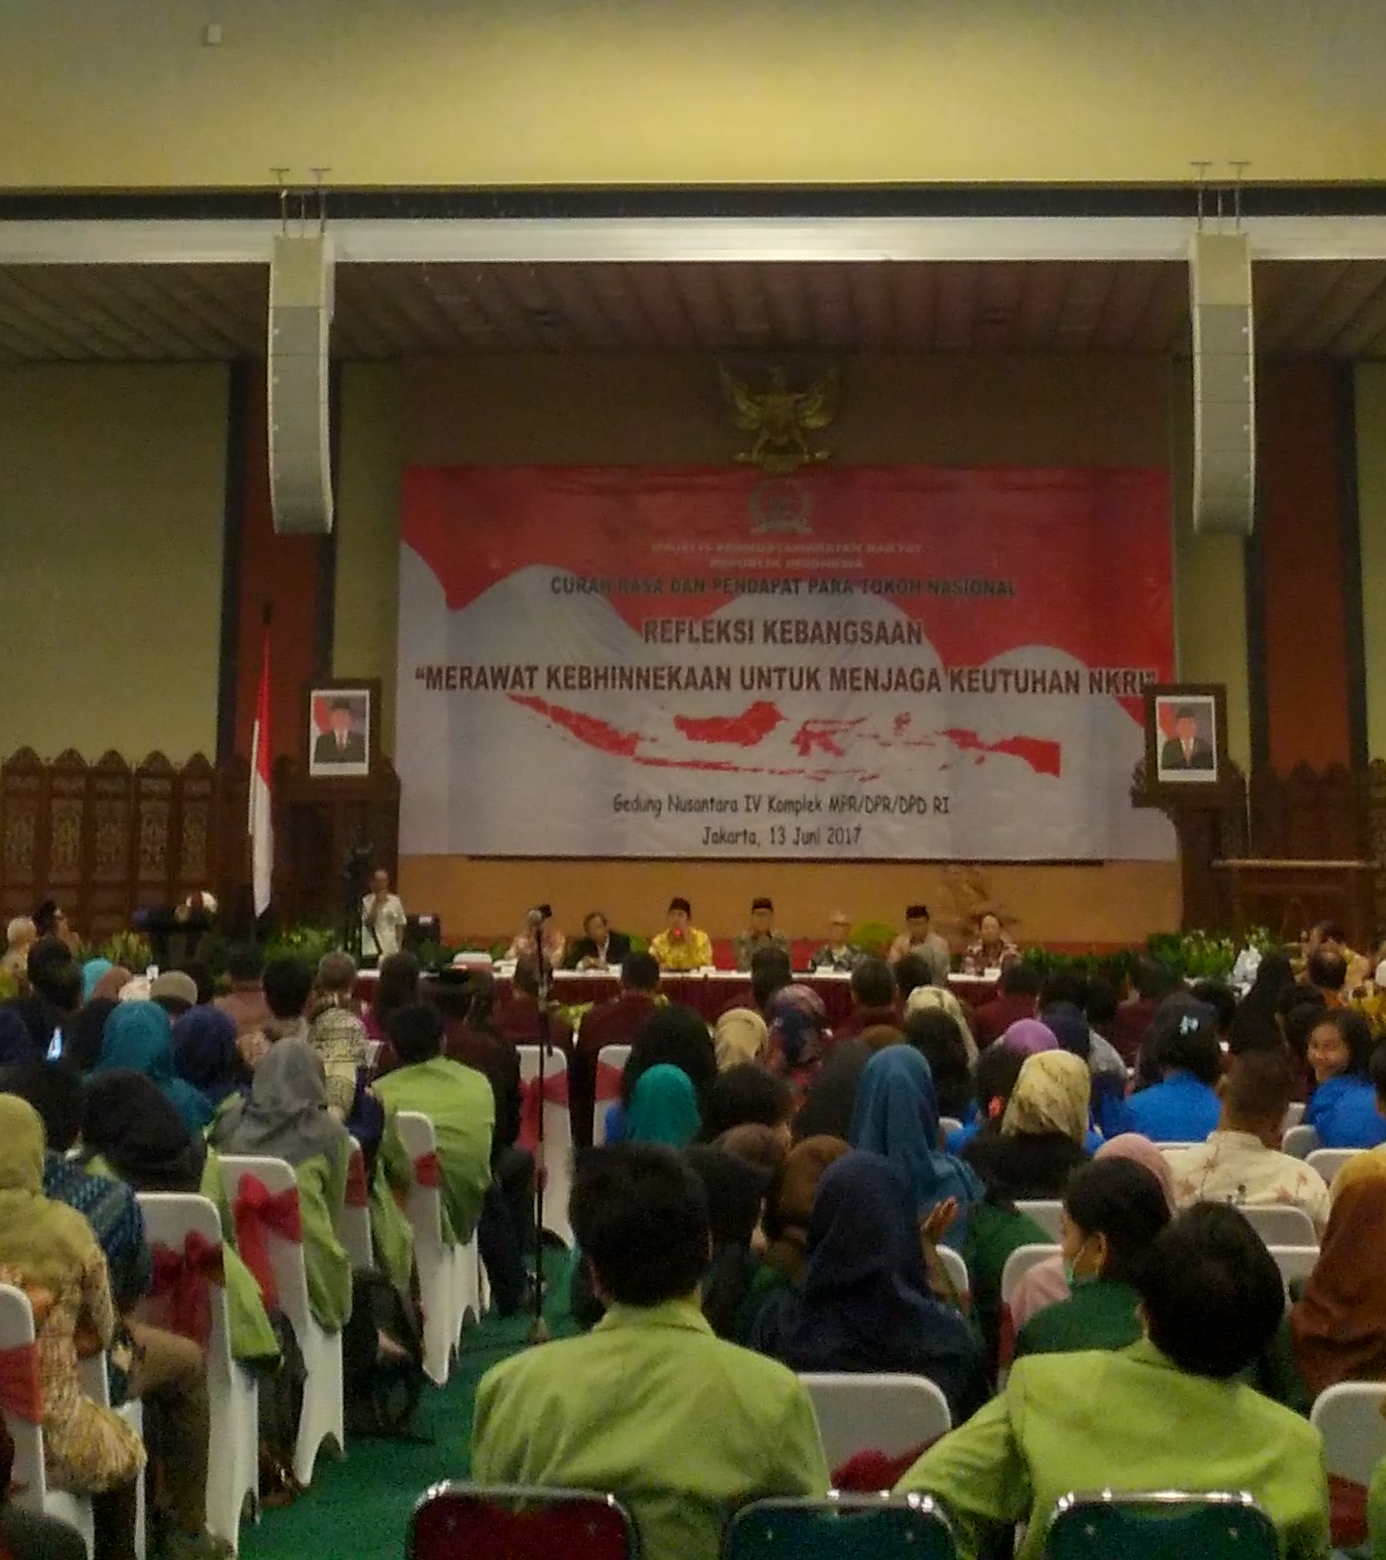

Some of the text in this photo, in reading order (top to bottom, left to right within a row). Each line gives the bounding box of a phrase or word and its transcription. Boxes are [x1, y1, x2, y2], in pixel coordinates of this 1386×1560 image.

[670, 576, 705, 594] DAN
[713, 577, 802, 594] PENDAPAT
[808, 578, 854, 594] PARA
[862, 578, 921, 595] TOKOH
[927, 579, 1017, 596] NASIONAL
[644, 618, 923, 645] REFLEKSI KEBANGSAAN
[545, 665, 732, 691] KEBHINNEKAAN
[739, 666, 822, 690] UNTUK
[829, 666, 942, 692] MENJAGA
[949, 668, 1080, 694] KEUTUHAN
[613, 793, 950, 818] Gedung Nusantara IV Komplek MPR/DPR/DPD RI
[701, 826, 861, 847] Jakarta, 13 Juni 2017
